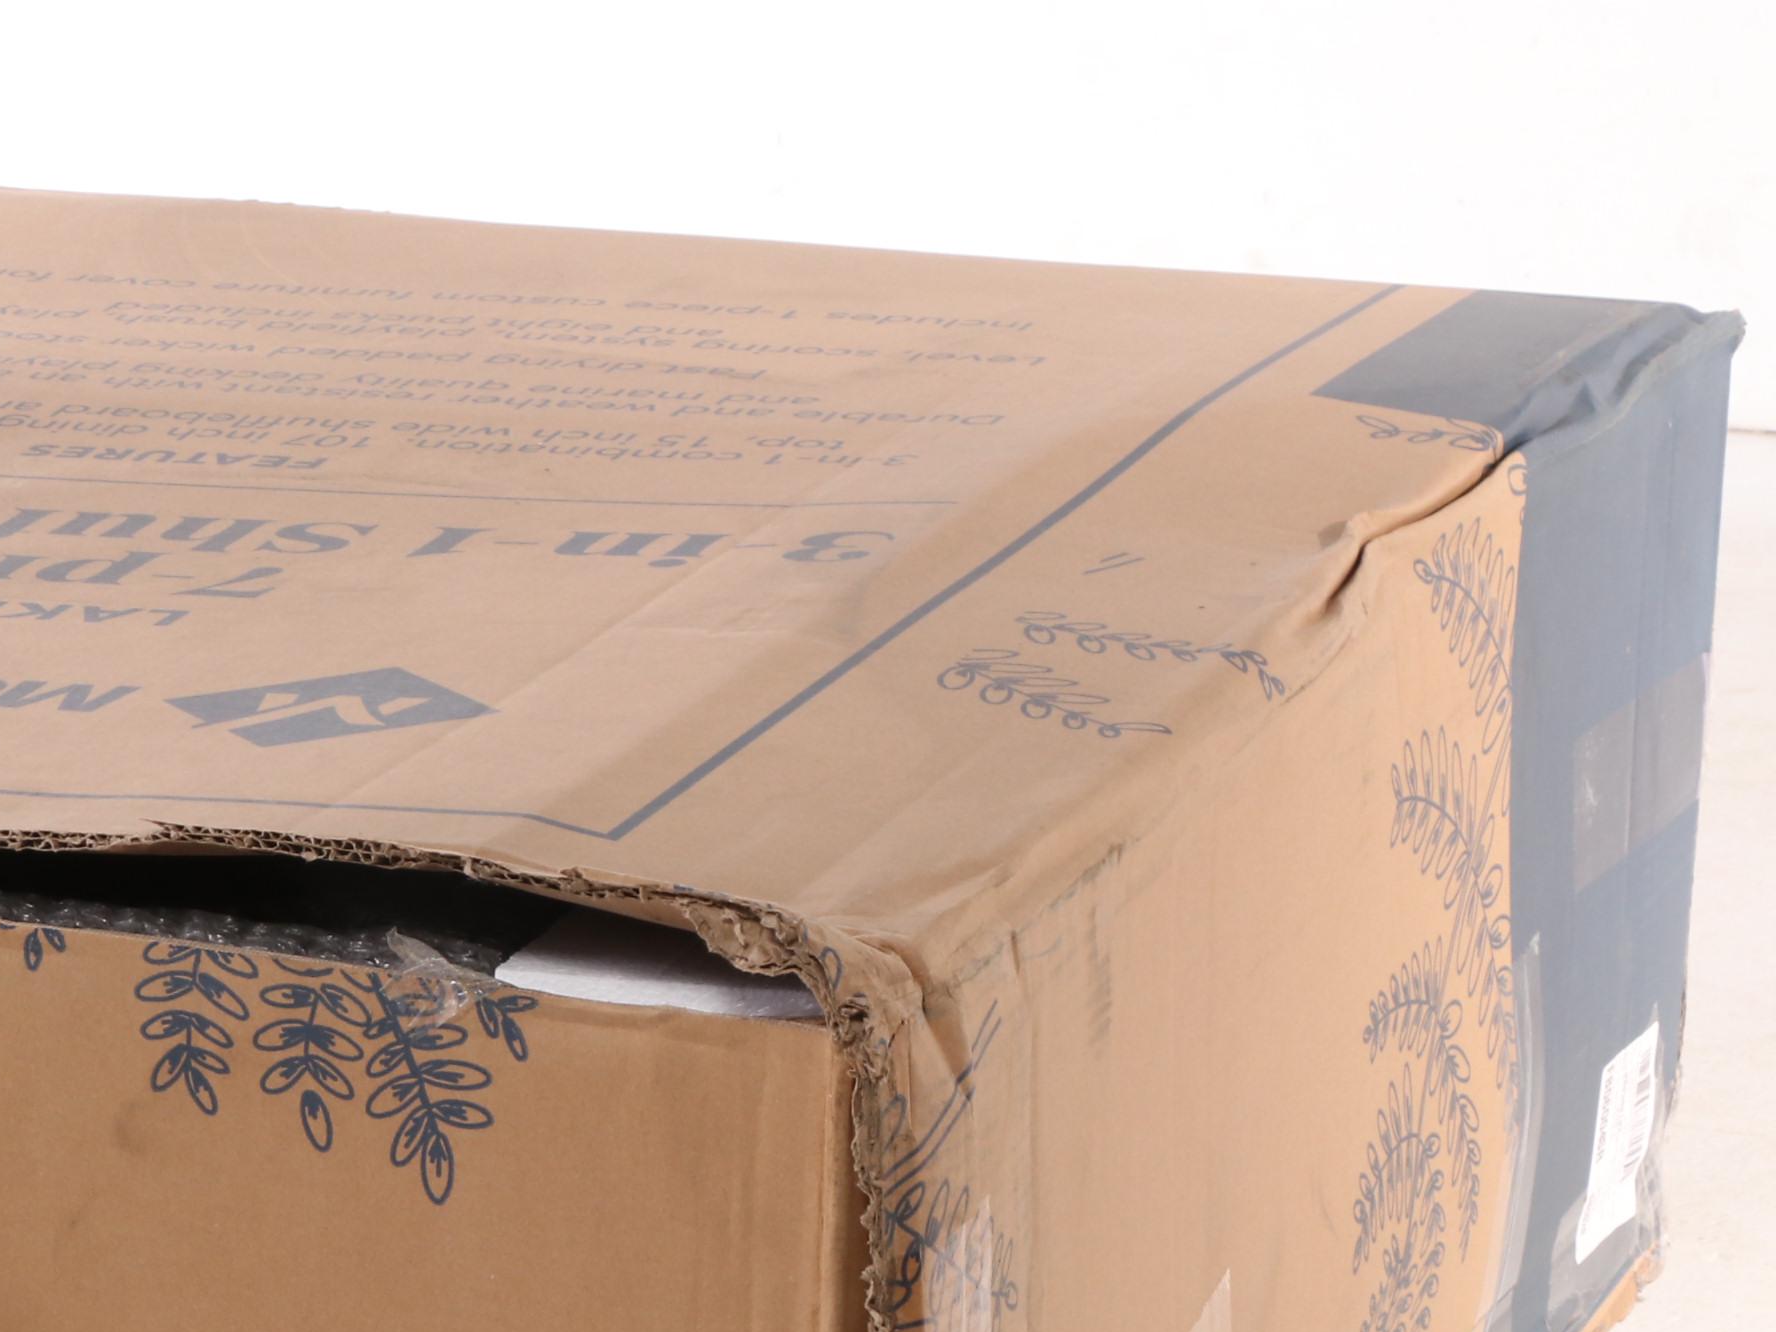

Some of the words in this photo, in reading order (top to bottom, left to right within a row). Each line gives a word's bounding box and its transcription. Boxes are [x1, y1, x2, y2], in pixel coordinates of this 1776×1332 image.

[64, 273, 199, 289] cover
[212, 281, 411, 301] furniture
[432, 290, 608, 306] custom
[102, 301, 317, 320] included
[624, 297, 798, 320] 1-piece
[257, 318, 473, 337] playfield
[319, 311, 476, 327] pucks
[487, 318, 614, 334] eight
[826, 309, 1040, 332] Includes
[616, 323, 726, 340] and
[101, 334, 256, 355] wicker
[694, 336, 881, 358] scoring
[264, 344, 475, 365] padded
[480, 350, 647, 374] drying
[32, 371, 88, 383] an
[128, 361, 325, 384] decking
[662, 363, 768, 382] Fast
[100, 376, 206, 390] with
[223, 380, 434, 401] resistant
[339, 371, 510, 395] quality
[527, 383, 704, 401] marine
[448, 392, 657, 413] weather
[717, 392, 816, 408] and
[48, 404, 379, 434] shuffleboard
[672, 404, 781, 419] and
[793, 409, 1007, 426] Durable
[166, 425, 272, 444] inch
[391, 421, 513, 441] wide
[531, 427, 638, 447] inch
[289, 433, 370, 449] 107
[657, 433, 707, 449] 15
[26, 442, 330, 471] FEATURES
[760, 451, 912, 470] 3-in-1
[409, 527, 896, 570] 3-in-1
